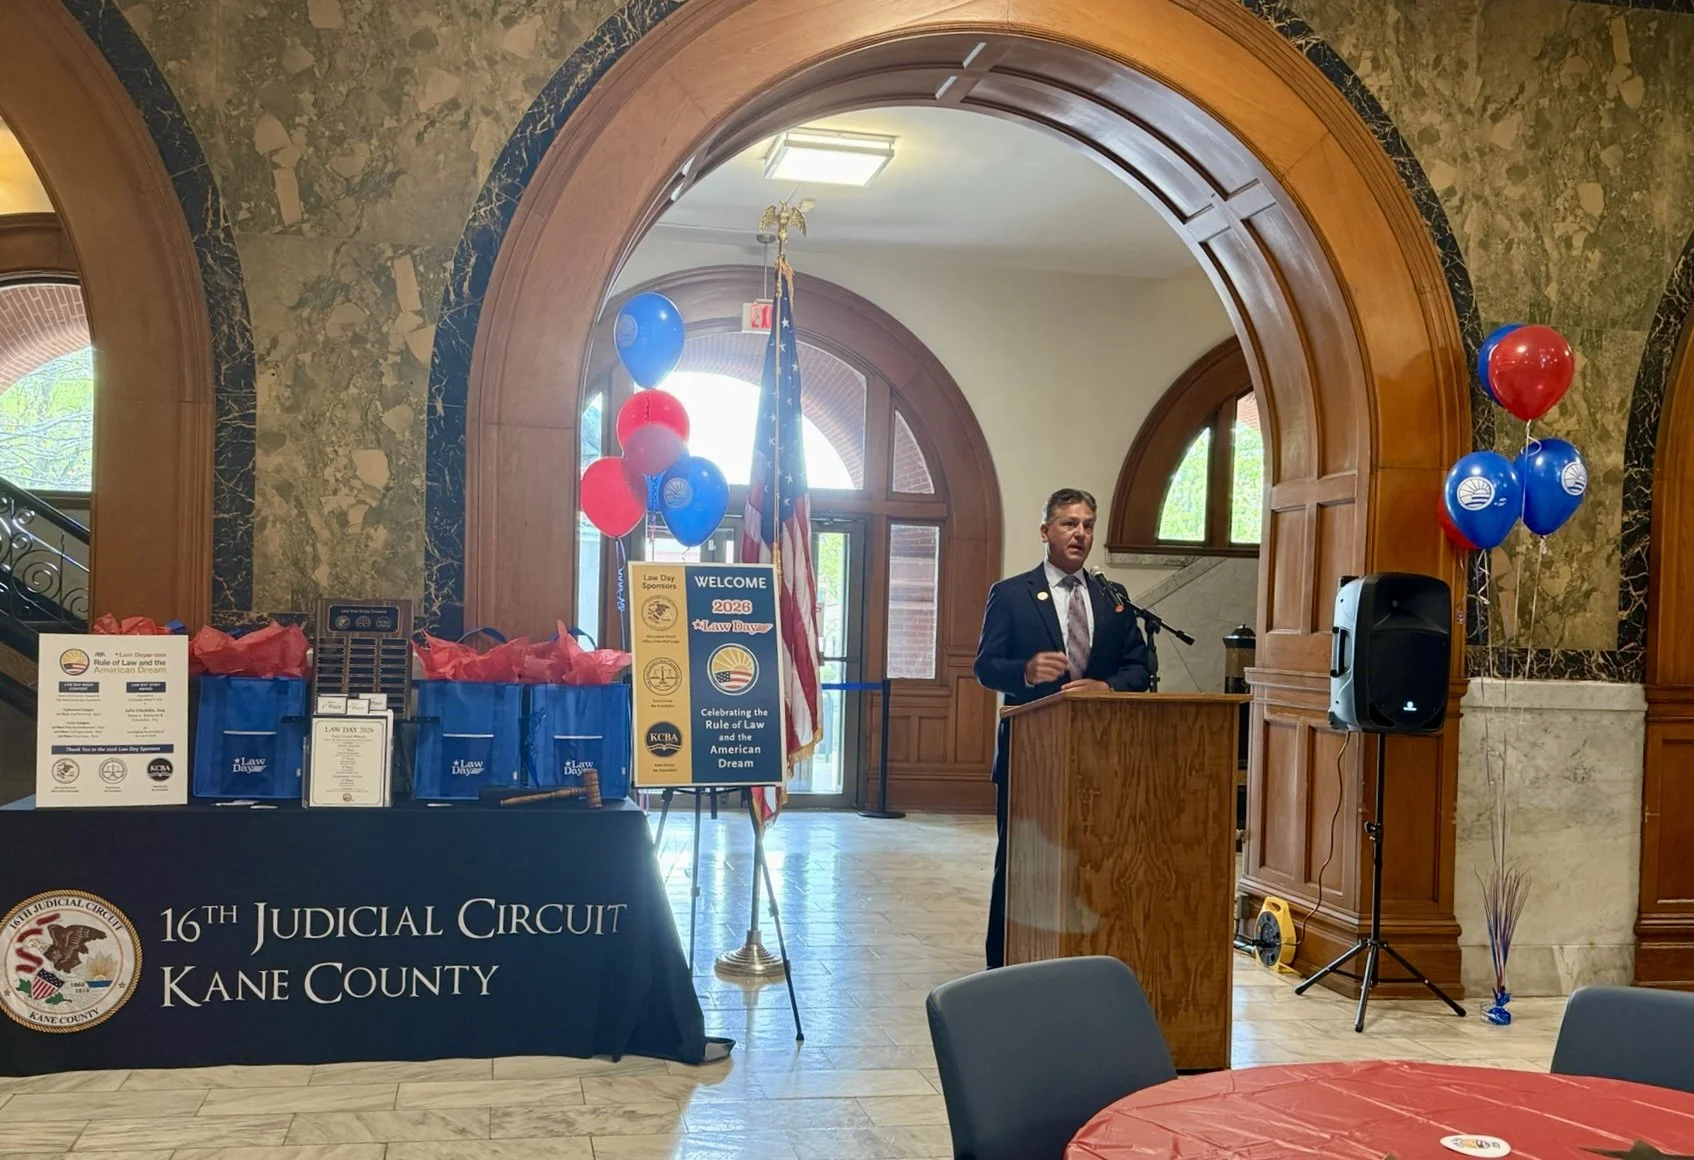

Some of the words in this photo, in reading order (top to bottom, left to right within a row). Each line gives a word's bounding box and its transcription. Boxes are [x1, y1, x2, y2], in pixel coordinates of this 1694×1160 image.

[660, 575, 675, 584] Day
[694, 576, 767, 588] WELCOME
[642, 582, 676, 590] Sponsors
[713, 600, 752, 614] 2026
[703, 620, 731, 632] Law
[732, 620, 758, 634] Day
[700, 708, 752, 718] Celebrating
[754, 708, 768, 716] the
[706, 720, 730, 729] Rule
[732, 720, 742, 728] of
[744, 721, 764, 729] Law
[650, 733, 678, 742] KCBA
[710, 745, 761, 754] American
[241, 757, 266, 766] Law
[718, 759, 754, 768] Dream
[233, 764, 252, 774] Day
[452, 766, 472, 776] Day
[564, 767, 582, 776] Day
[10, 910, 32, 930] 16TH
[33, 898, 84, 912] JUDICIAL
[86, 902, 122, 931] CIRCUIT
[160, 905, 237, 943] 16TH
[250, 902, 444, 956] JUDICIAL
[457, 898, 628, 940] CIRCUIT
[160, 966, 290, 1008] KANE
[304, 962, 500, 1004] COUNTY
[30, 1011, 58, 1024] KANE
[60, 1008, 99, 1024] COUNTY
